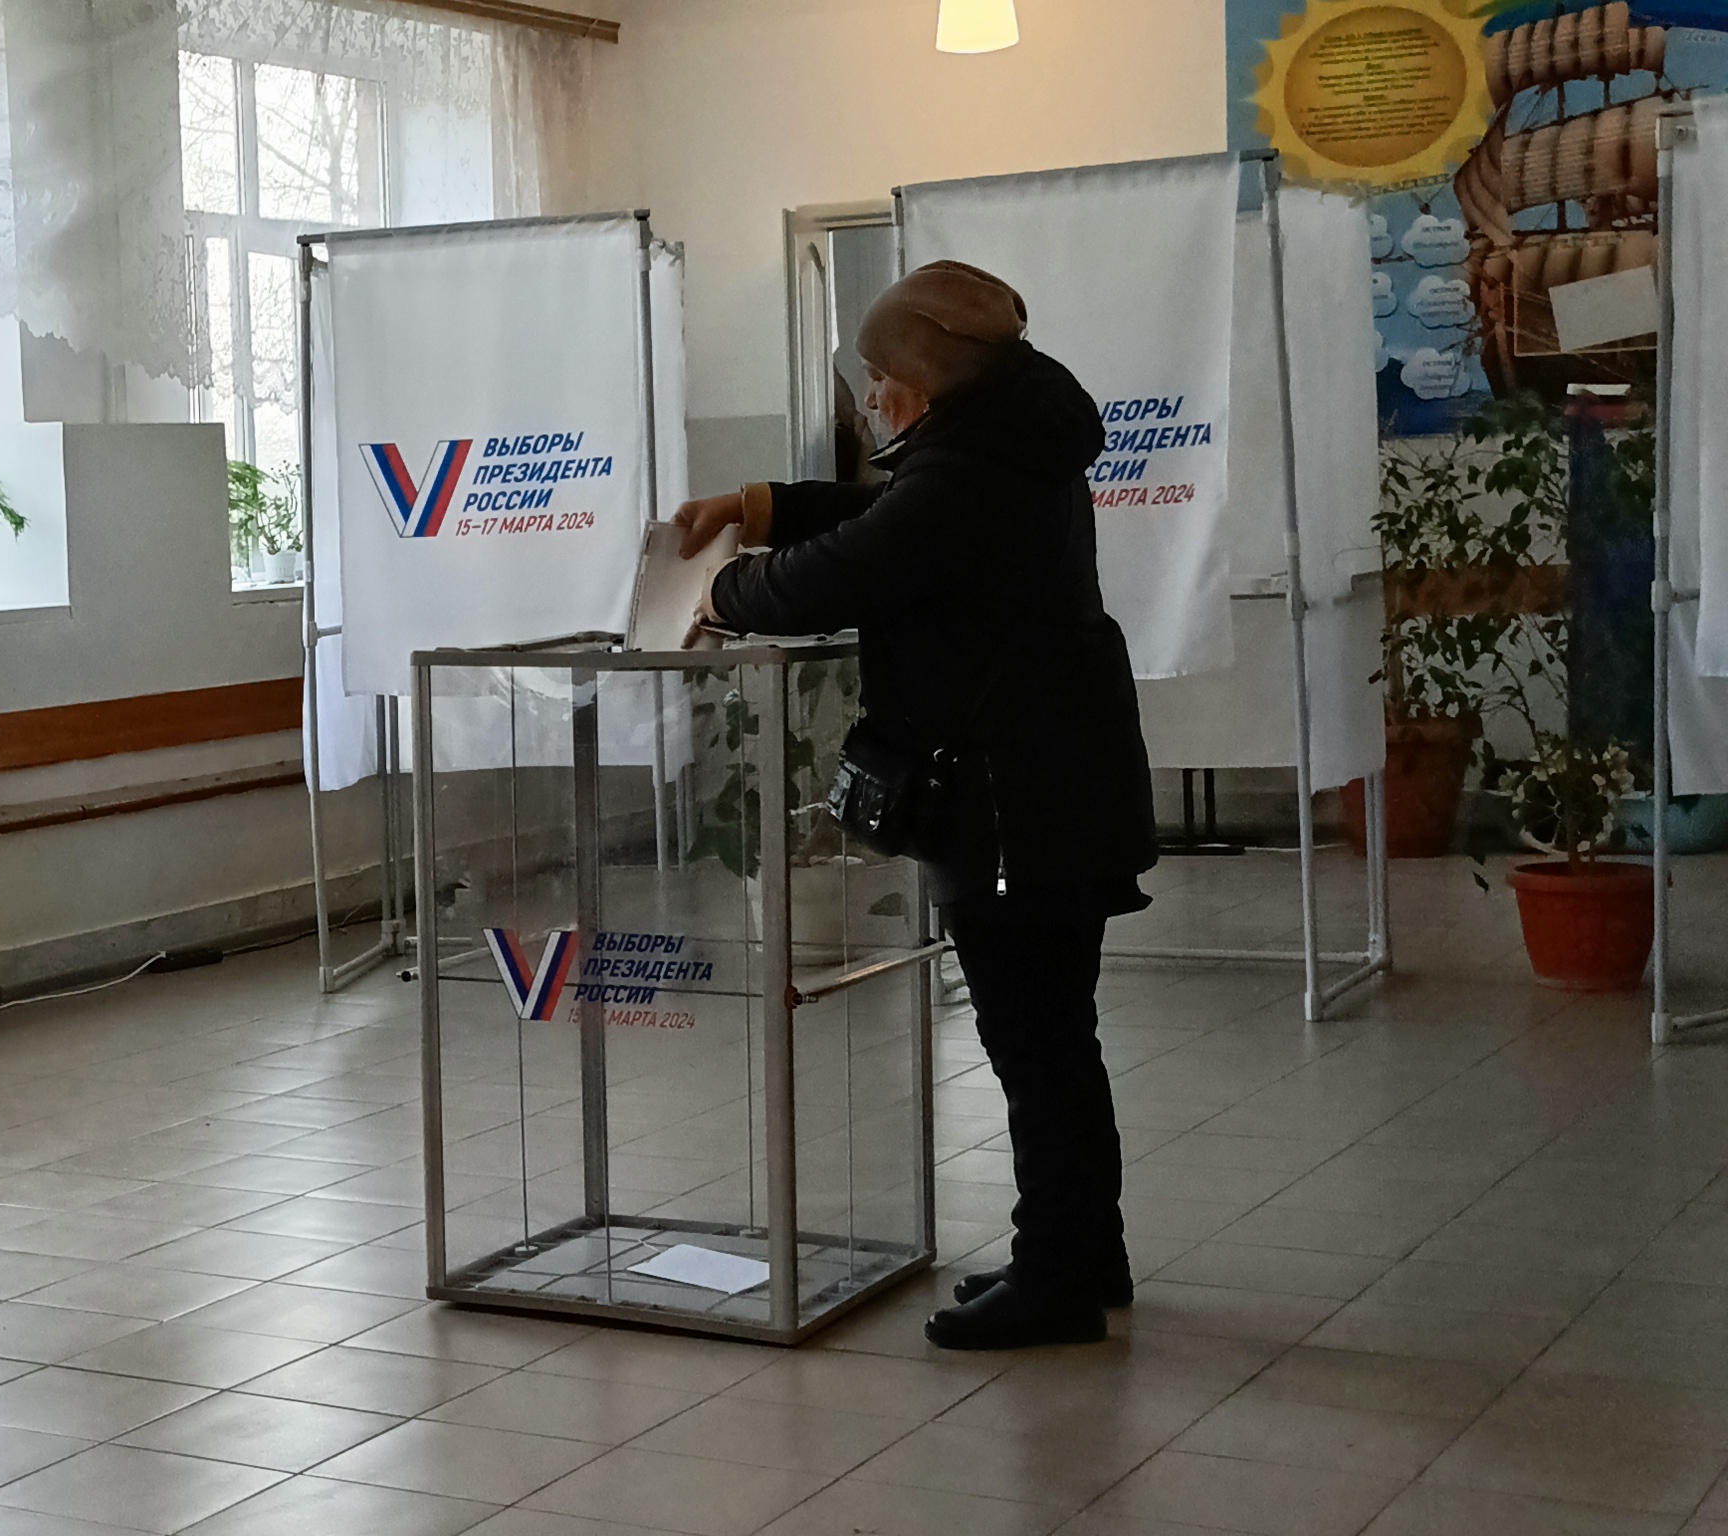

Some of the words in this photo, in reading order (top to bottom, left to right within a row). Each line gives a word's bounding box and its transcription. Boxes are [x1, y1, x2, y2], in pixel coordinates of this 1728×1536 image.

[1101, 395, 1185, 423] БОРЫ
[482, 431, 584, 458] ВЫБОРЫ
[1103, 421, 1211, 454] ЗИДЕНТА
[472, 456, 613, 485] ПРЕЗИДЕНТА
[462, 488, 554, 513] РОССИИ
[1150, 482, 1196, 506] 2024
[498, 513, 554, 535] МАРТА
[556, 511, 595, 531] 2024
[592, 932, 686, 954] ВЫБОРЫ
[583, 957, 714, 983] ПРЕЗИДЕНТА
[574, 984, 656, 1005] РОССИИ
[607, 1009, 659, 1028] МАРТА
[659, 1012, 696, 1030] 2024
